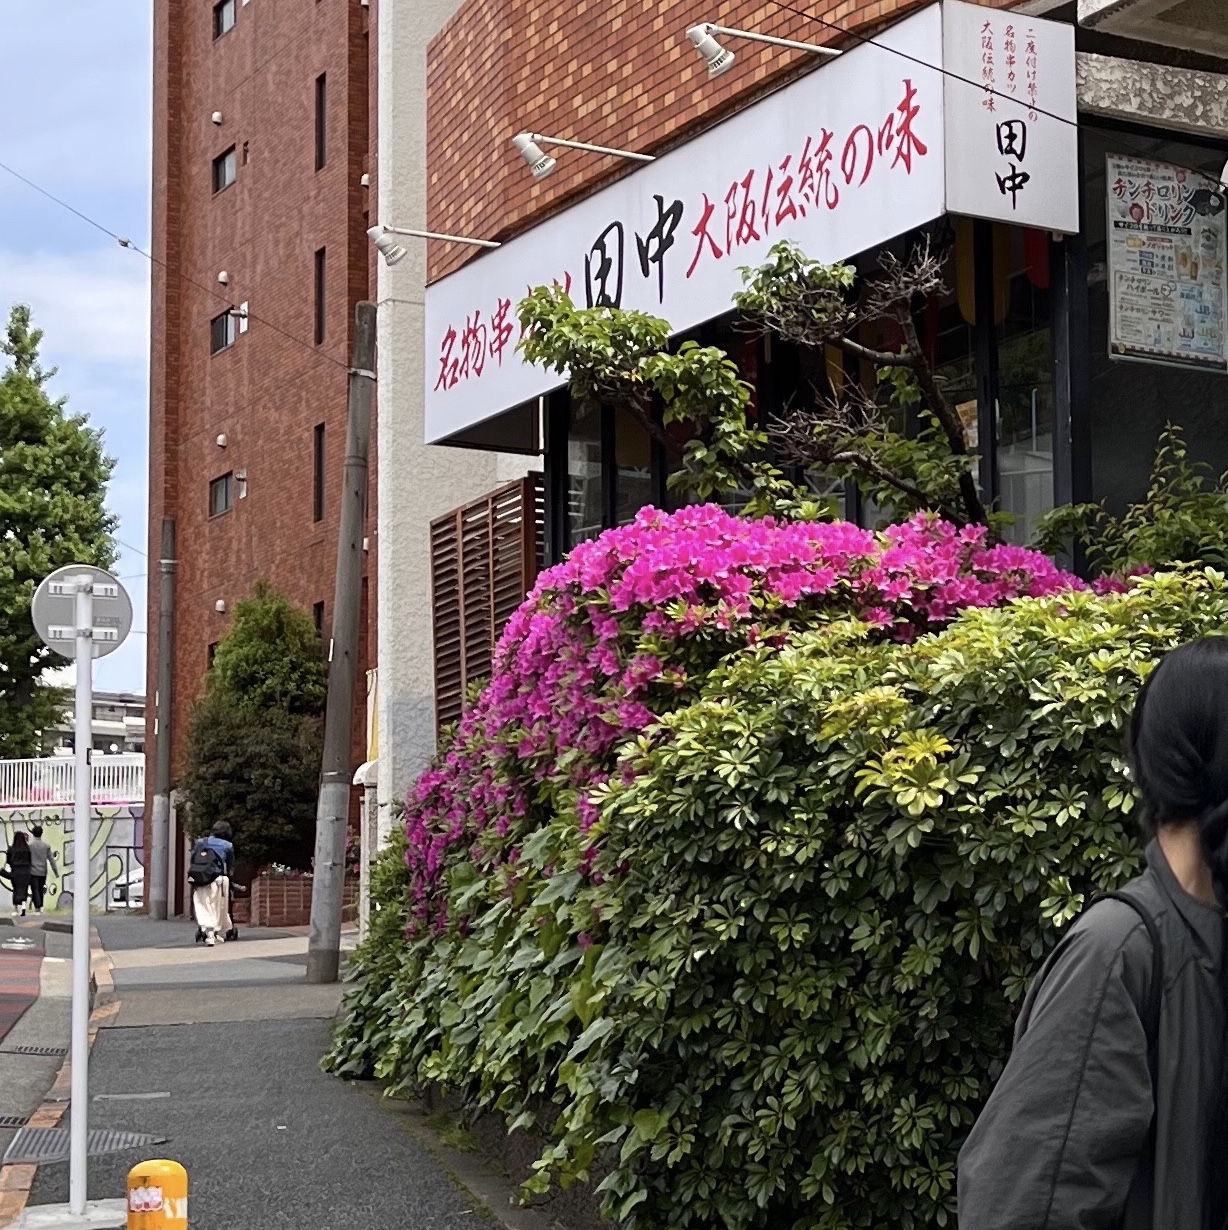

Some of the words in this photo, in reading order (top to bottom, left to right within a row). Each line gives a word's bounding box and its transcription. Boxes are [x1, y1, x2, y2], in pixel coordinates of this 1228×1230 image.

[1003, 24, 1017, 94] 名物串カツ
[584, 193, 684, 309] 田中
[686, 79, 928, 279] 大阪伝統の味
[994, 119, 1031, 210] 田中
[1112, 177, 1196, 205] チンチロリン
[1144, 200, 1196, 226] ドリンク
